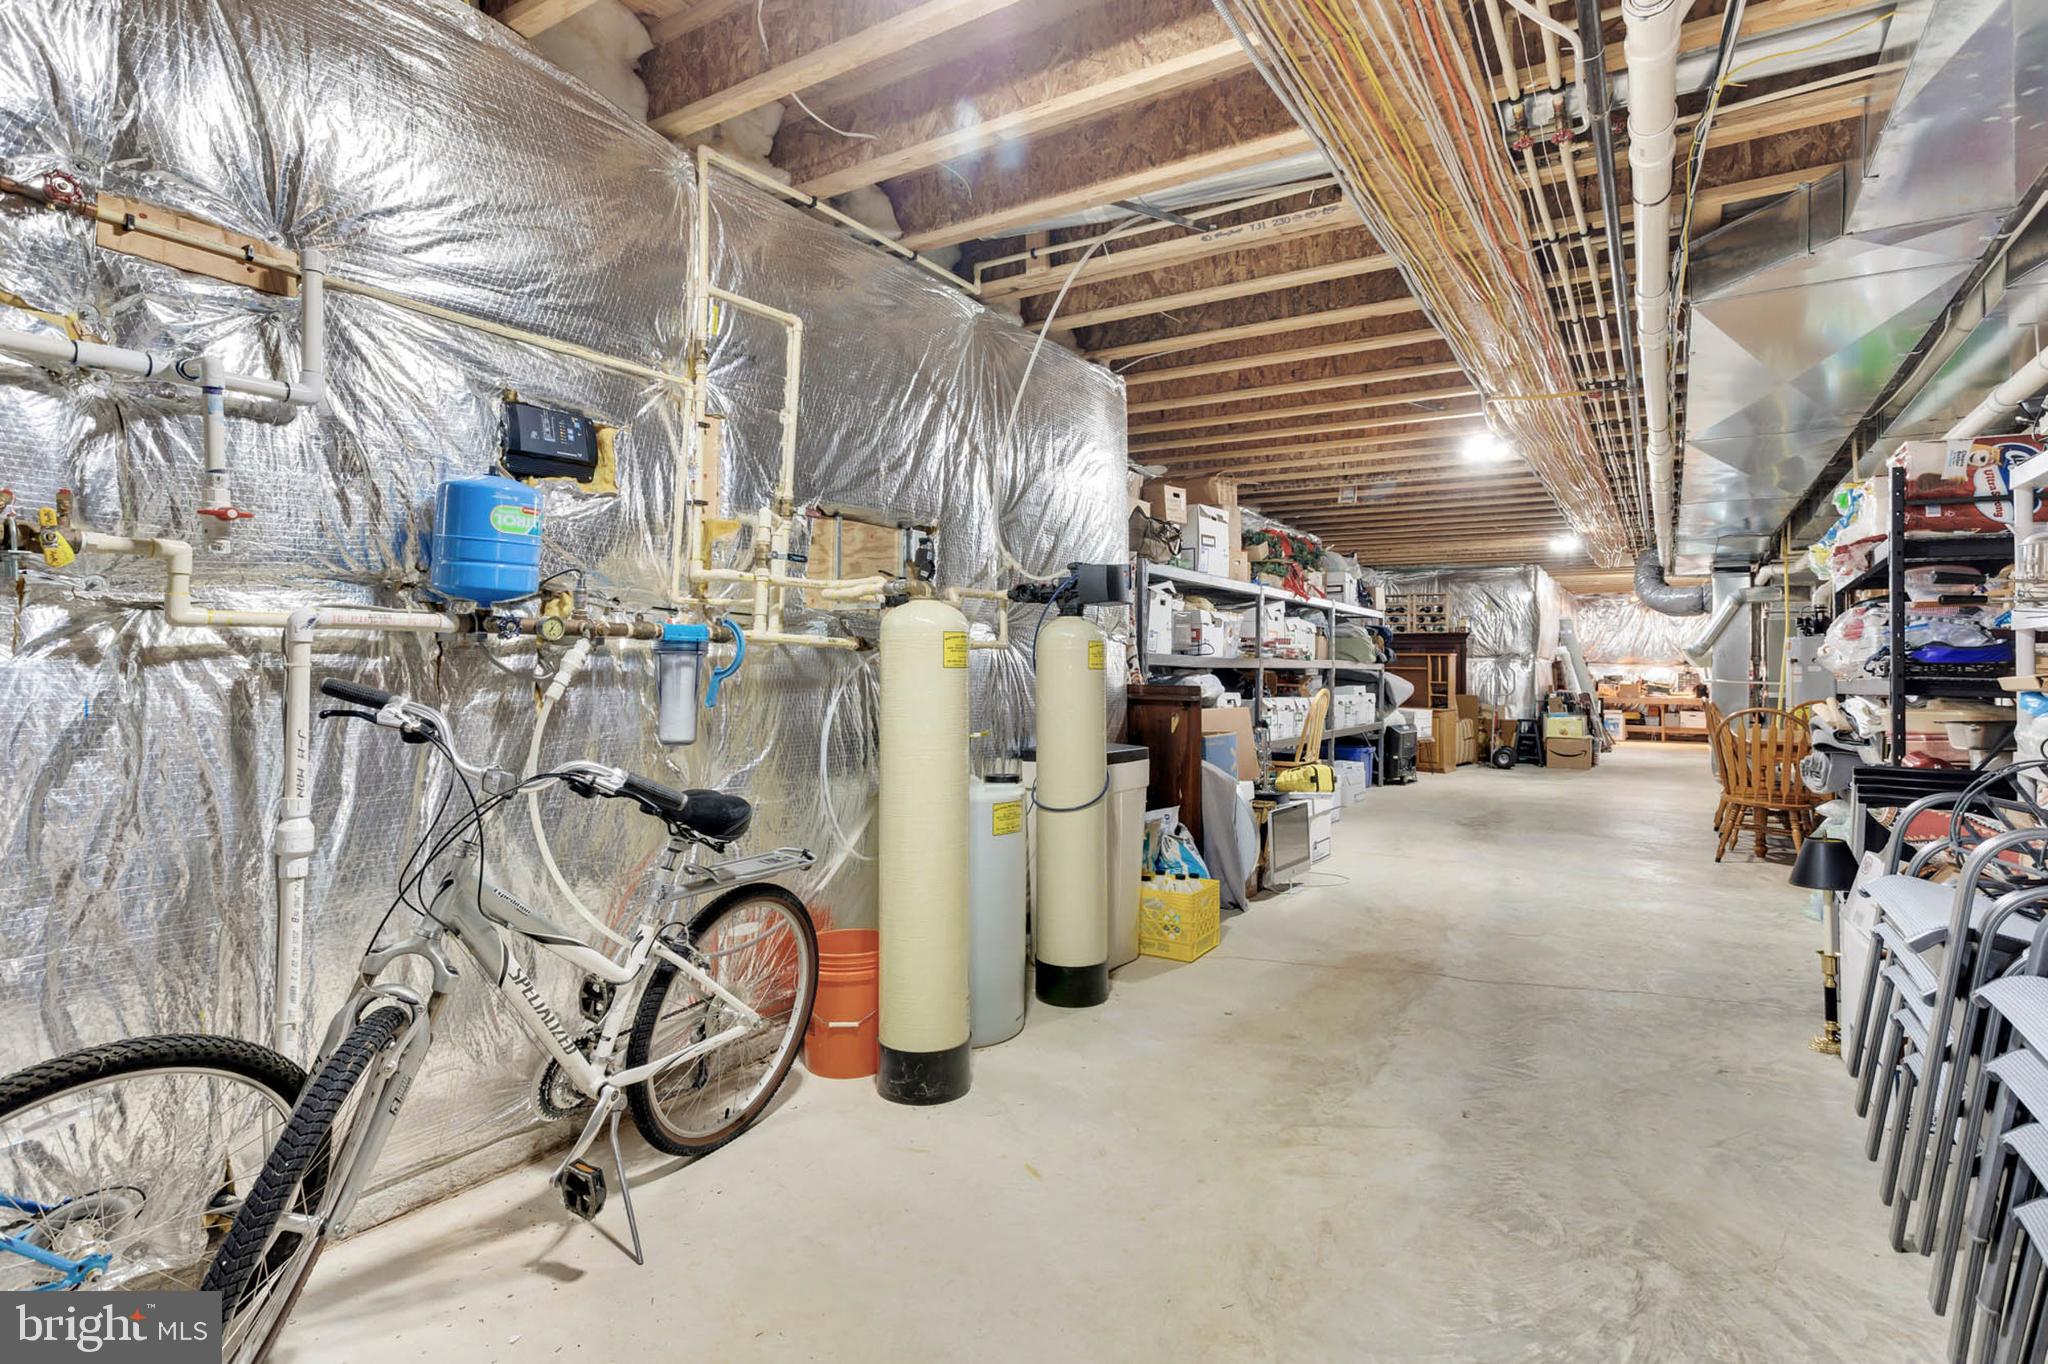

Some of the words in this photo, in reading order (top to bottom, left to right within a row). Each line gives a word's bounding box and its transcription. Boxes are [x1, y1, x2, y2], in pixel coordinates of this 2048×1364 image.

[1983, 469, 1997, 492] Ultra
[1991, 491, 2004, 518] Song
[507, 967, 578, 1056] SPECIALIZED
